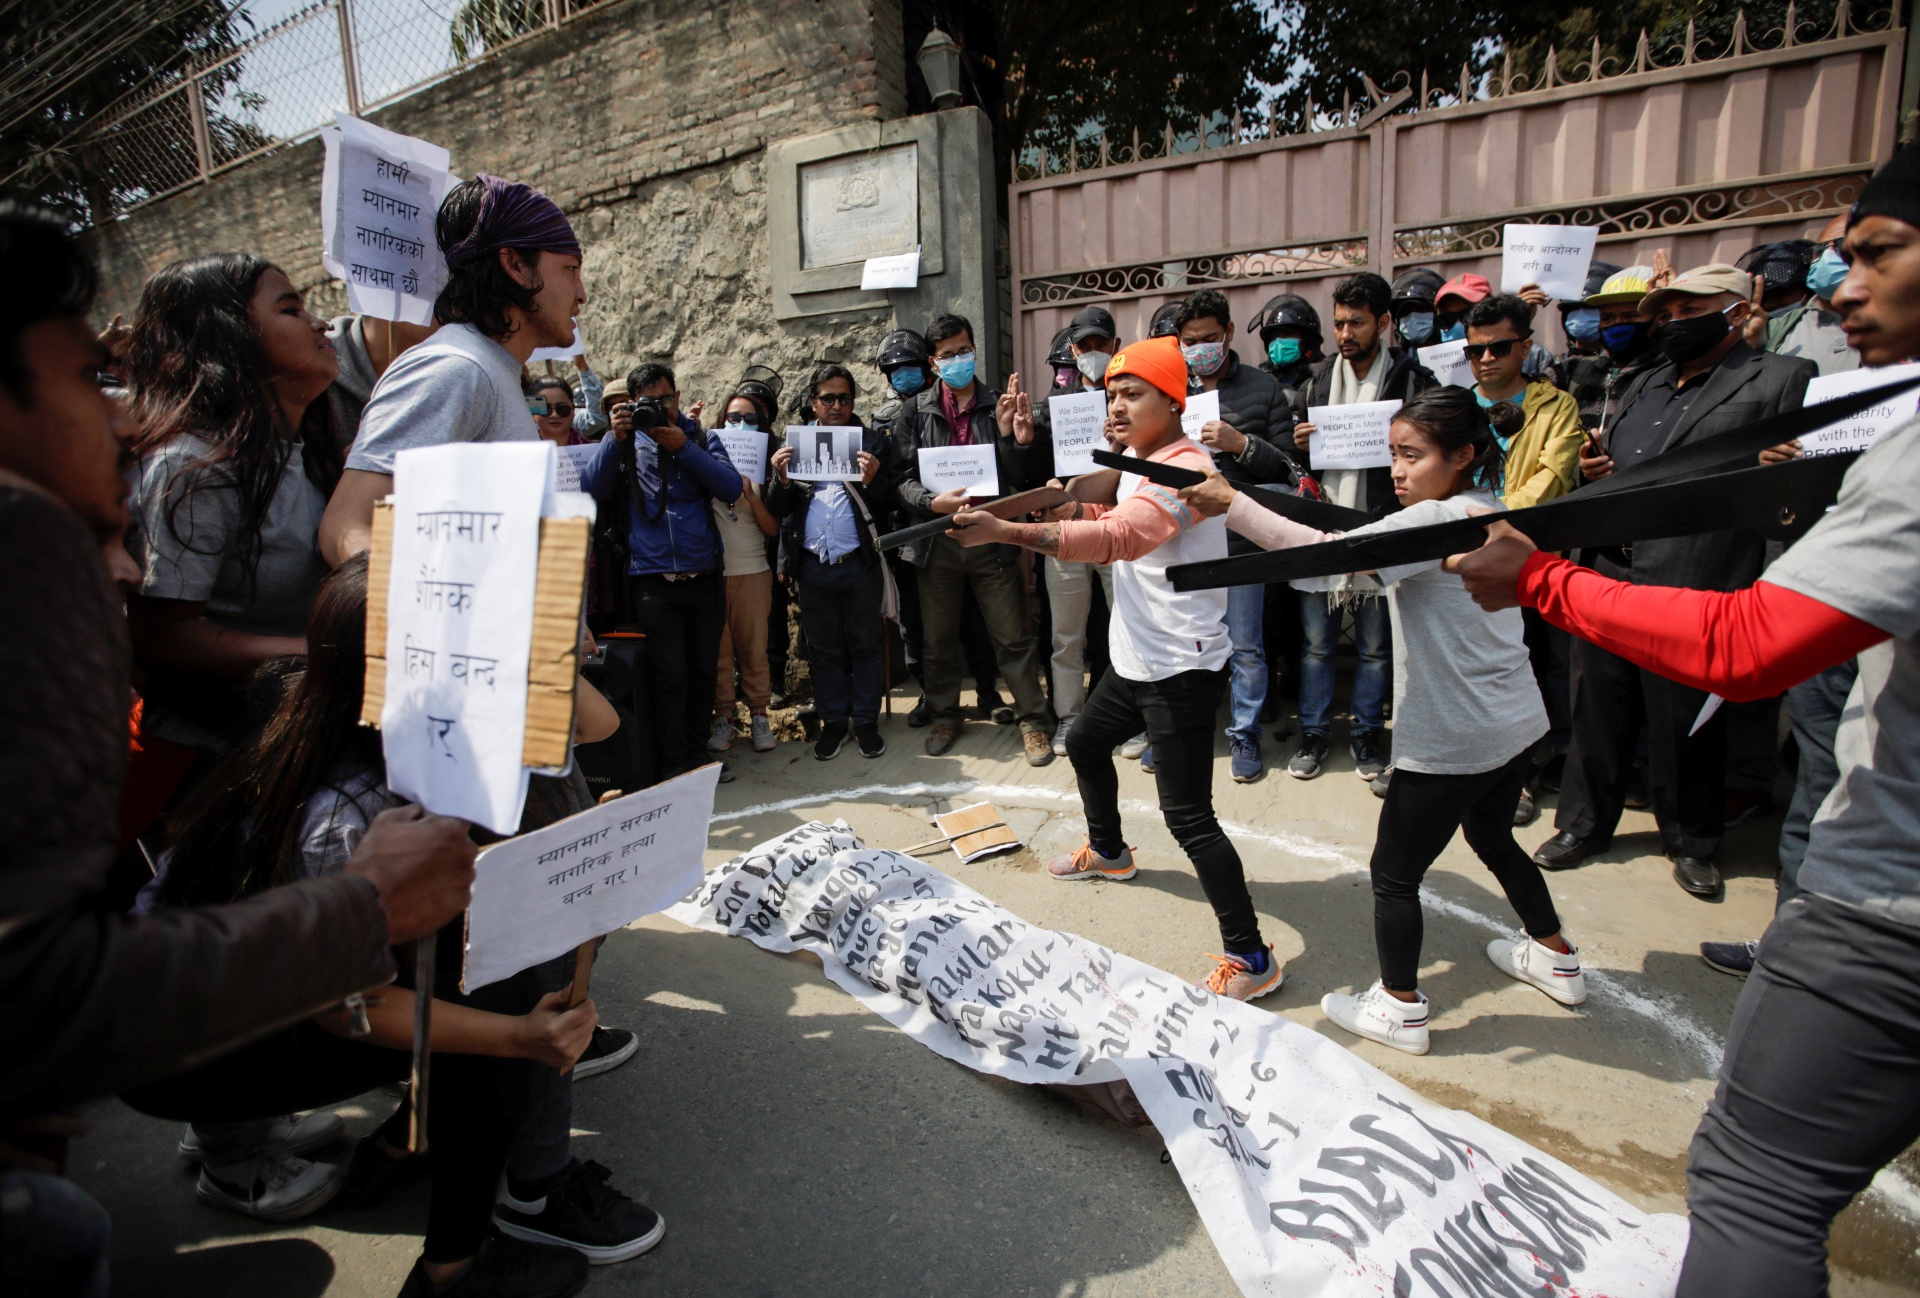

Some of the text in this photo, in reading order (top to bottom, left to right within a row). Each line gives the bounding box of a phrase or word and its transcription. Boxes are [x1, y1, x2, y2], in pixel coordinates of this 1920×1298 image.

[377, 157, 411, 186] हामी
[362, 188, 421, 224] म्यानमार
[356, 226, 425, 260] नागरिकको
[1540, 244, 1581, 256] आन्दोलन
[1543, 263, 1553, 272] छ
[351, 263, 395, 289] साथमा
[1073, 404, 1095, 413] Stand
[1065, 416, 1099, 426] Solidarity
[1323, 422, 1354, 431] PEOPLE
[1364, 420, 1383, 428] More
[1323, 432, 1353, 440] Powerful
[1818, 427, 1876, 442] with the
[1058, 437, 1092, 447] PEOPLE
[1354, 439, 1385, 447] POWER
[1327, 450, 1382, 460] #SaveMyanmar
[416, 511, 503, 543] म्यानमार
[537, 803, 672, 865] म्यानमार सरकार
[548, 832, 656, 886] नागरिक हत्या
[739, 853, 791, 937] Total
